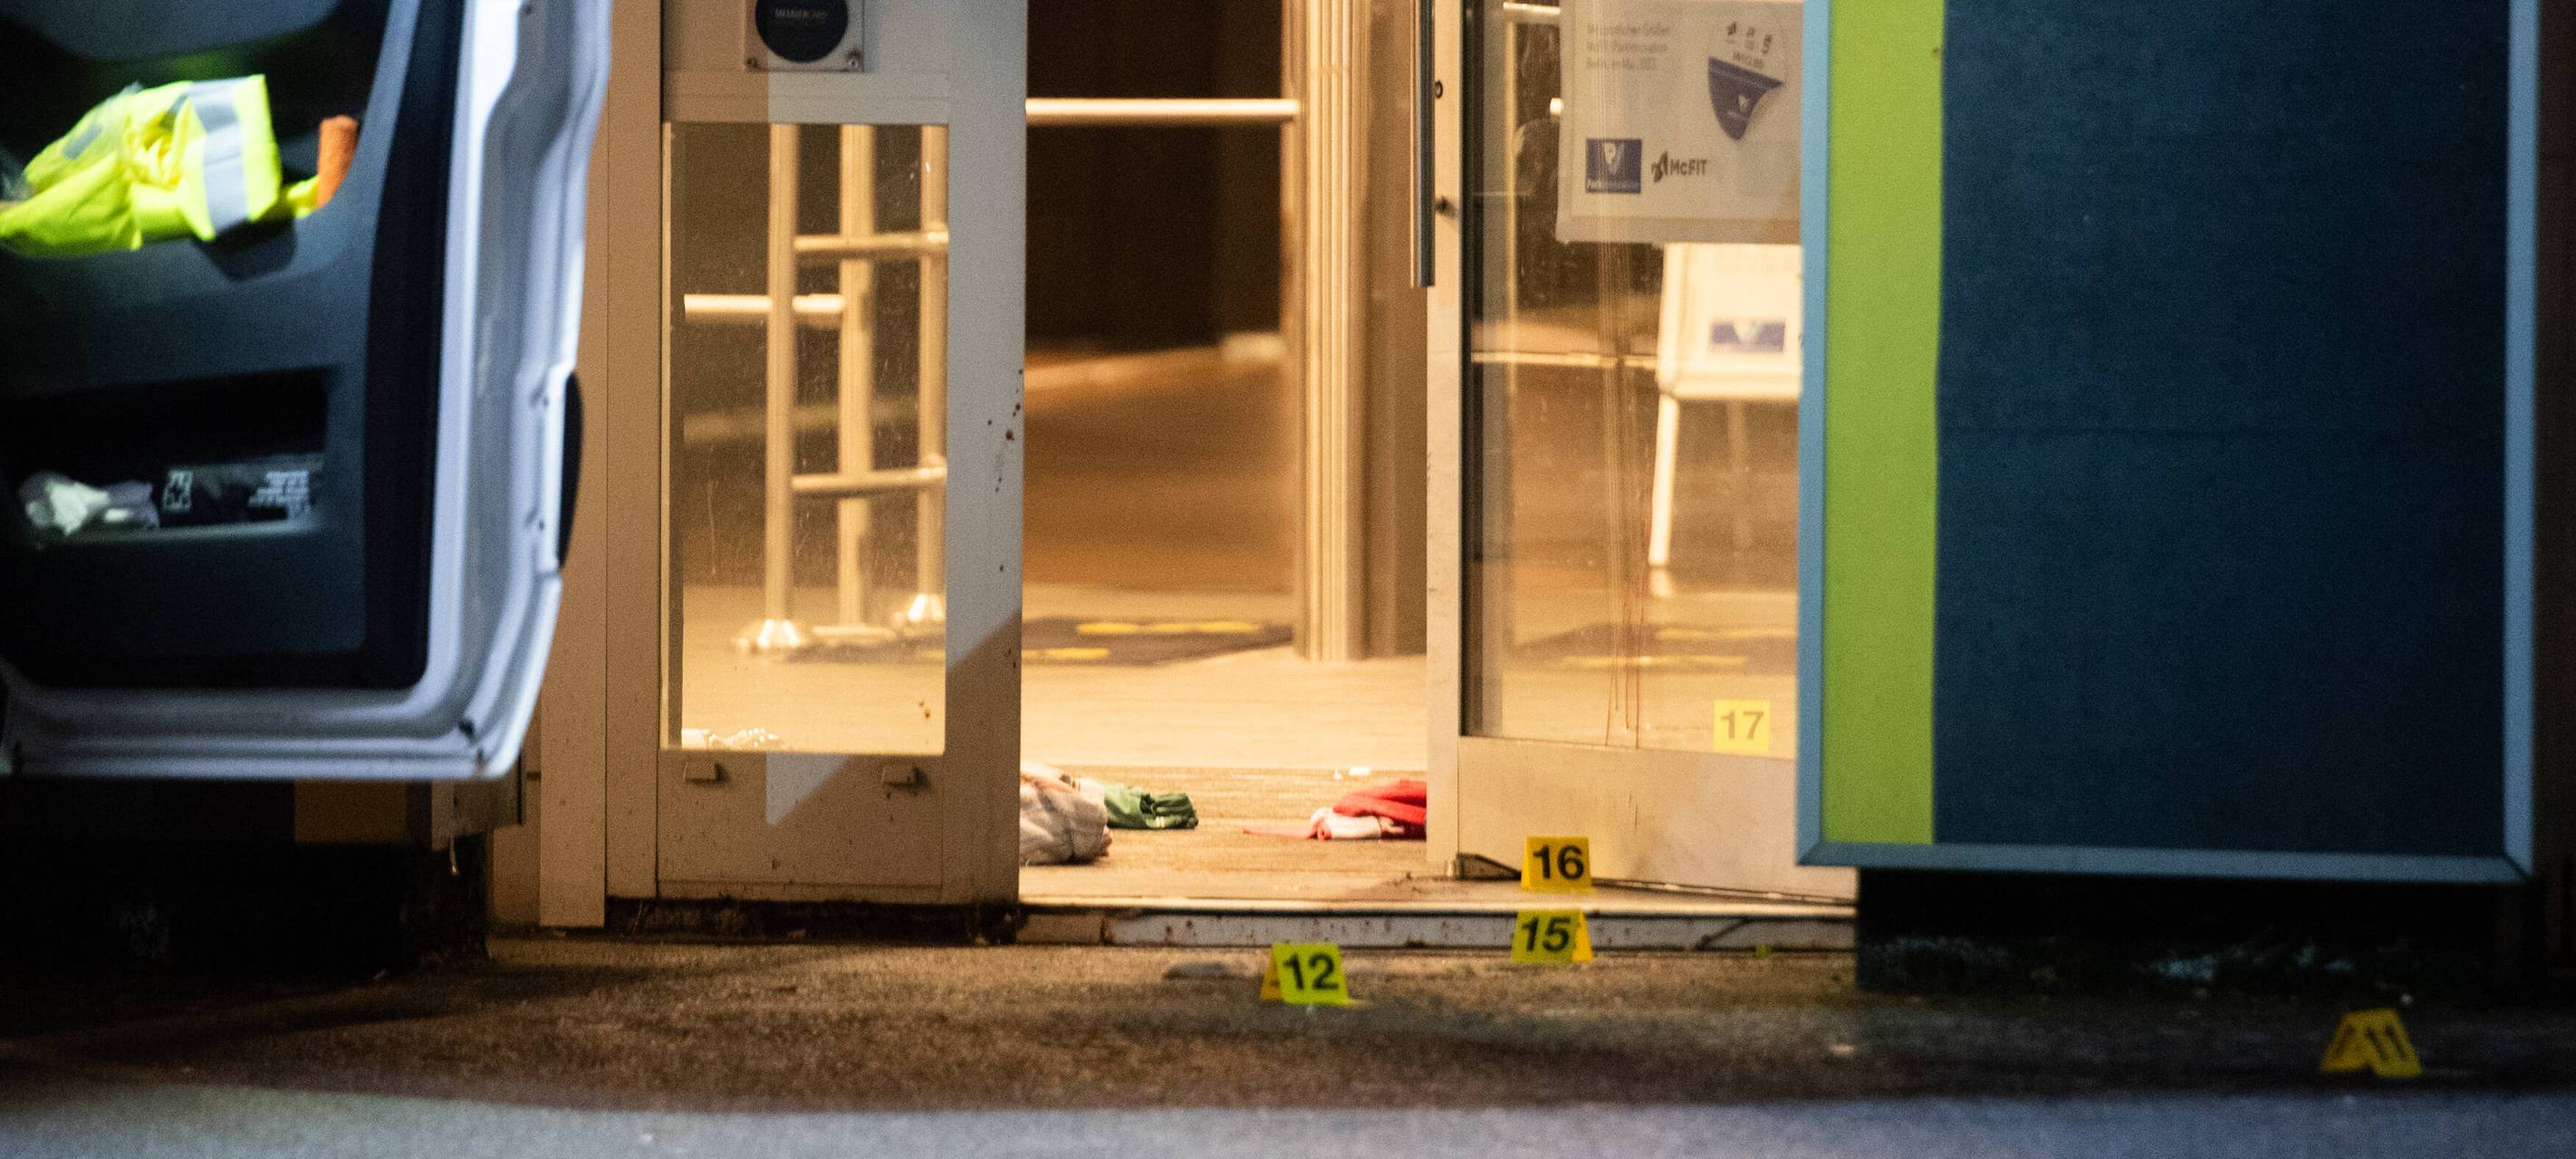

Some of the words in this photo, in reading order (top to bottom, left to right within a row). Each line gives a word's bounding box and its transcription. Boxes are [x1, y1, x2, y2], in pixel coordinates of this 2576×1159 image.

[1669, 158, 1707, 176] McFIT
[1720, 710, 1764, 740] 17
[1533, 844, 1585, 881] 16
[1521, 916, 1571, 953] 15
[1283, 952, 1339, 991] 12
[2363, 1024, 2410, 1062] 11
